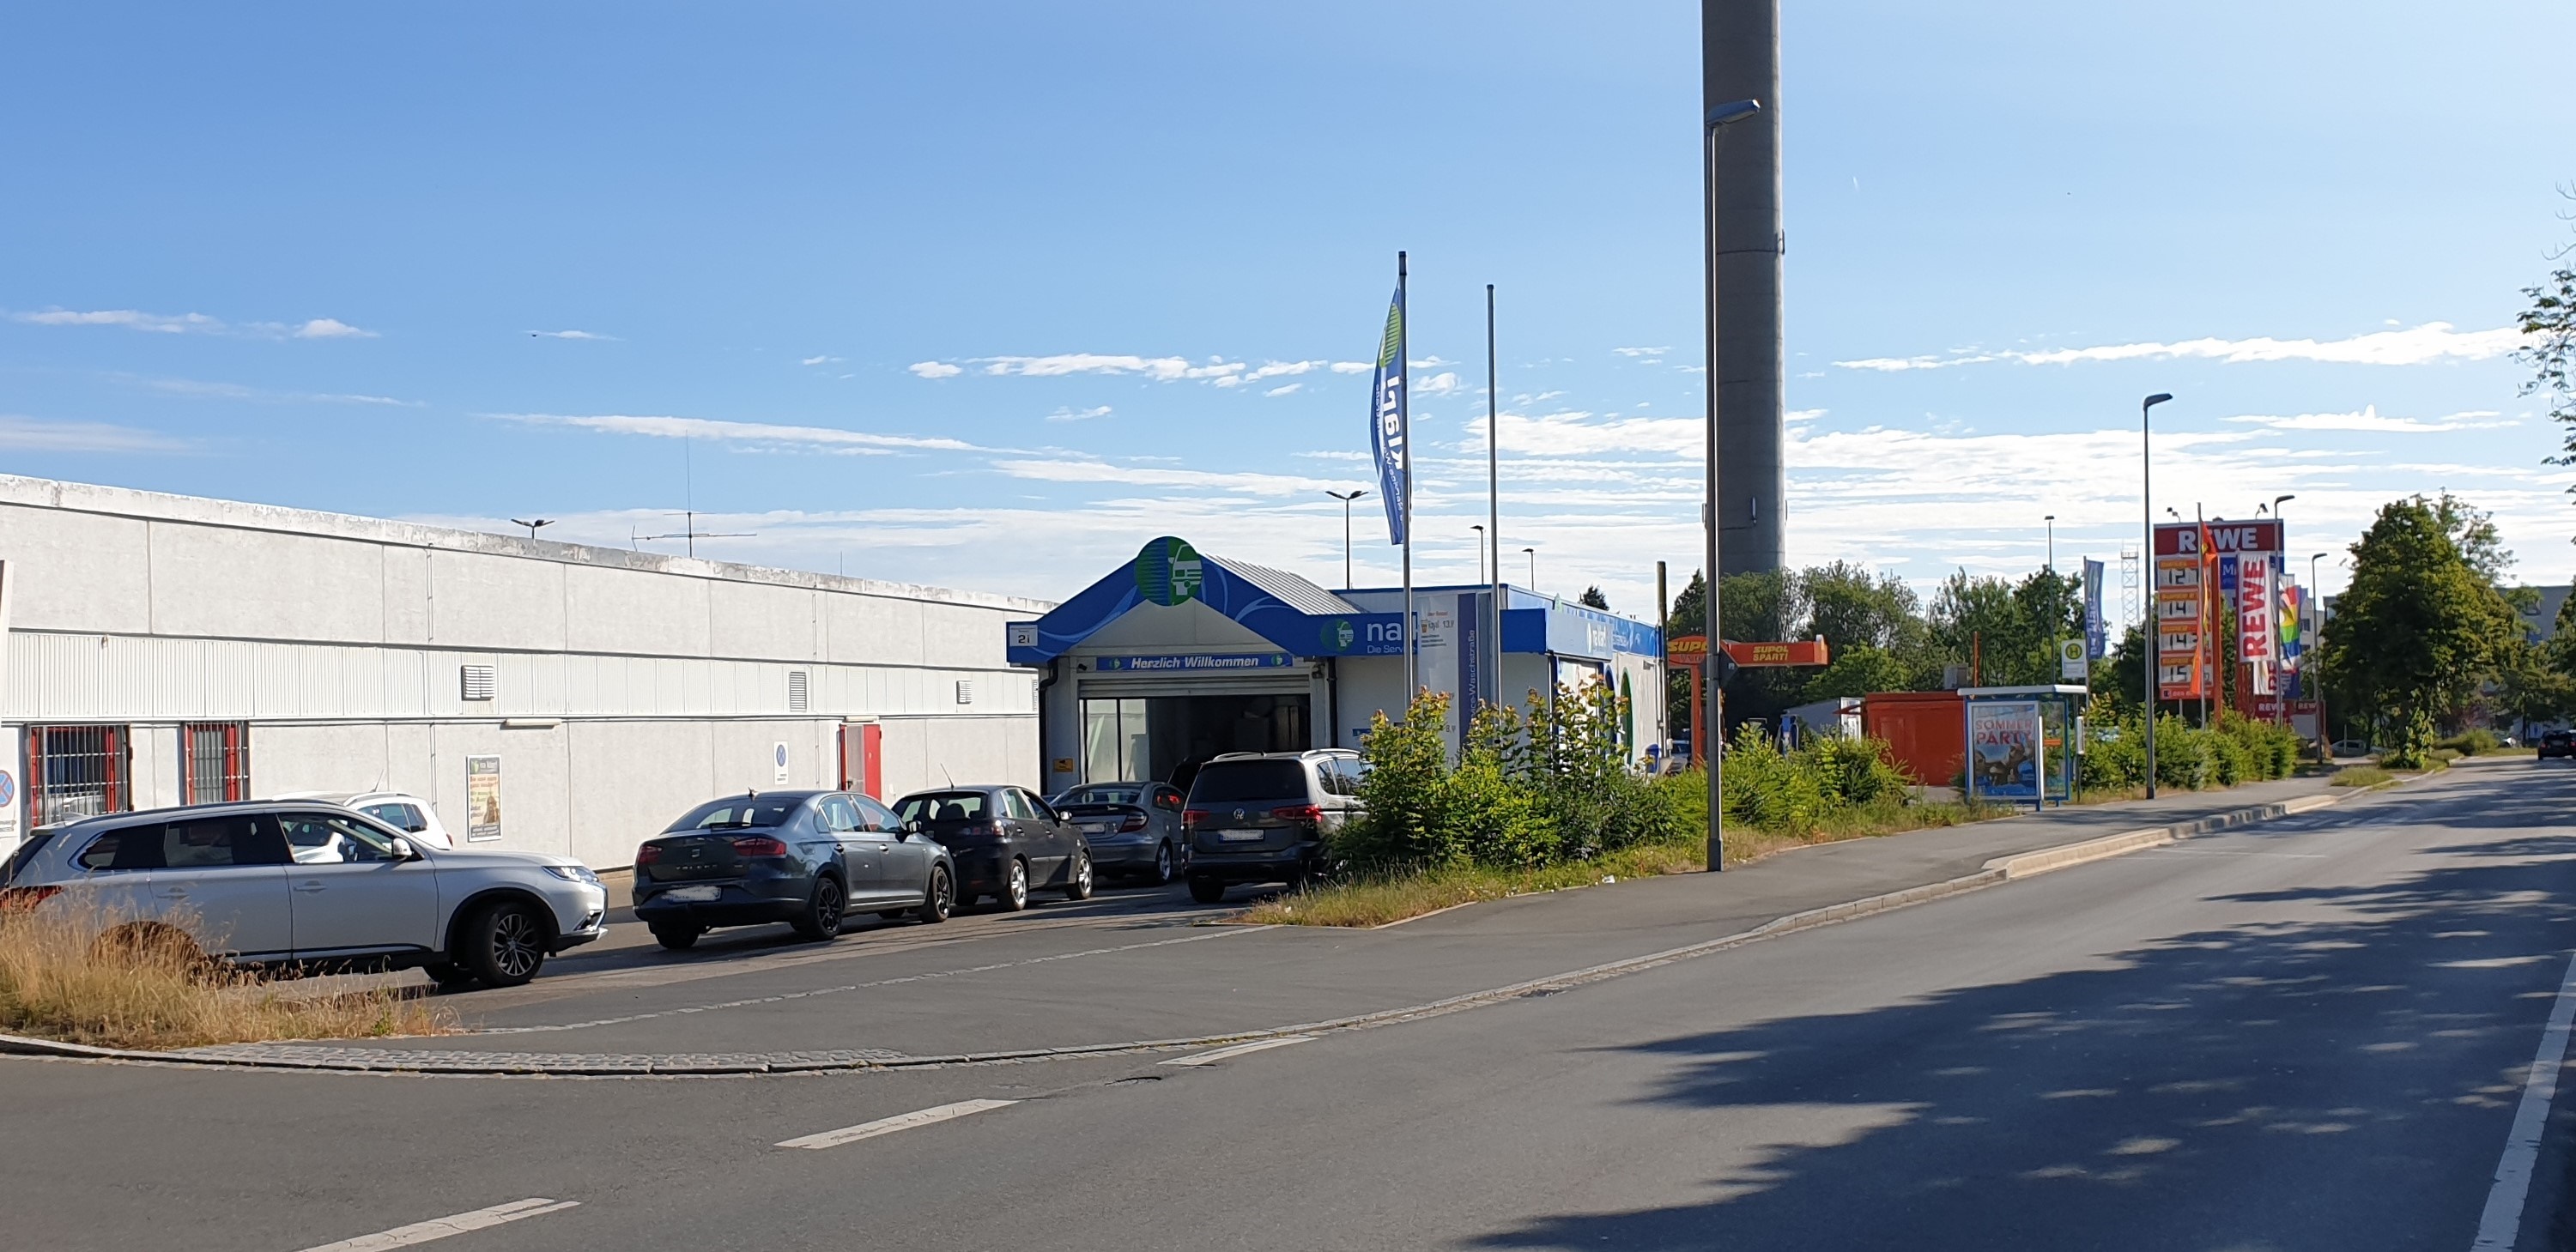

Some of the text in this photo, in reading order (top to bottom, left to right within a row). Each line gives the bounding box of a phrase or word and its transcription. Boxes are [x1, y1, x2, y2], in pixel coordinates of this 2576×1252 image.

[2178, 527, 2258, 551] RWE
[2169, 602, 2187, 616] 14
[2242, 559, 2268, 657] REWE
[1367, 644, 1382, 654] Die
[1668, 641, 1708, 652] SUPO
[1130, 656, 1259, 669] Herzlich Willkommen
[1468, 629, 1477, 717] vice-Waschstraße
[2169, 665, 2187, 681] 15
[1976, 720, 2033, 730] SOMMER
[1976, 729, 2033, 745] PARTY
